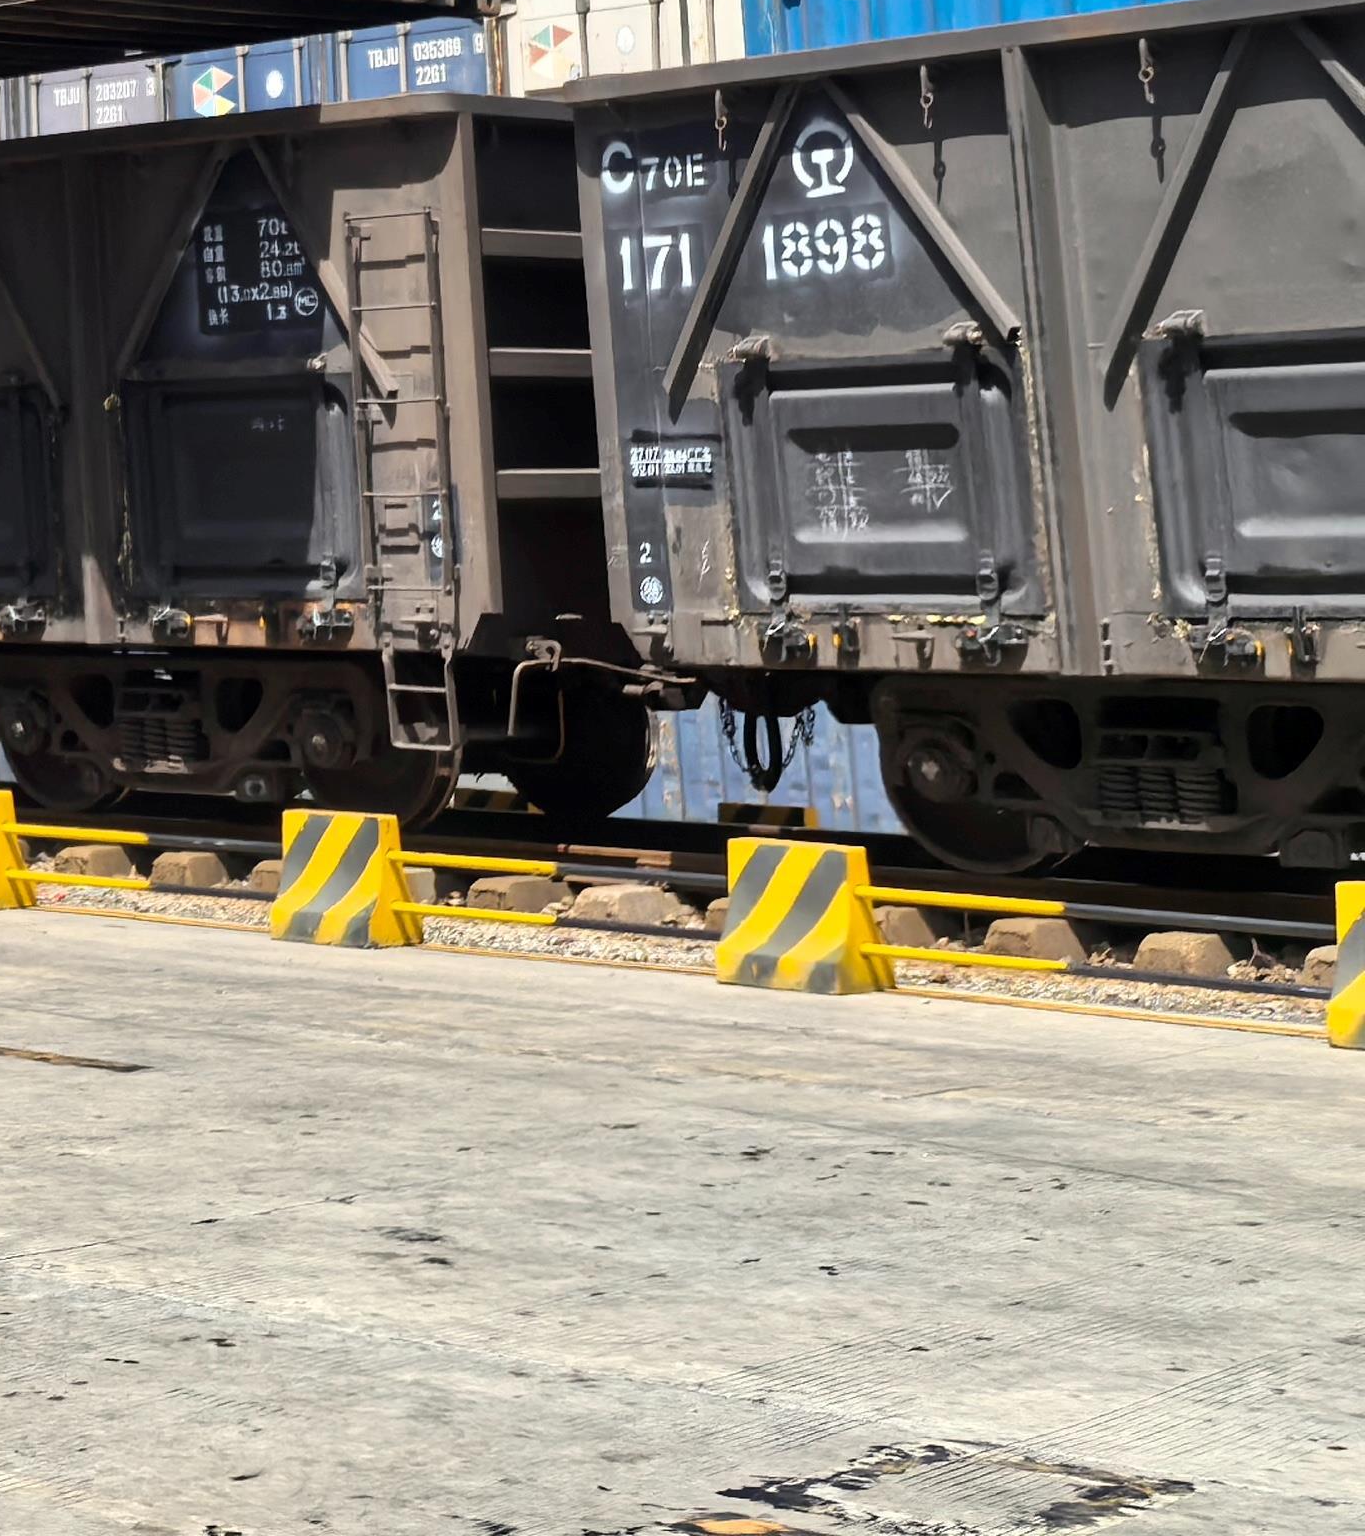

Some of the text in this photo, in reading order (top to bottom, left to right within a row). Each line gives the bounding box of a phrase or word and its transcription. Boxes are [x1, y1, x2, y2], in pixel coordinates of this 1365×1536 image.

[368, 47, 399, 69] TBJU
[415, 63, 447, 86] 22G1
[53, 87, 80, 107] TBJU
[601, 141, 708, 194] C70E
[257, 218, 289, 237] 70t
[620, 214, 885, 291] 171 1898
[639, 542, 653, 564] 2
